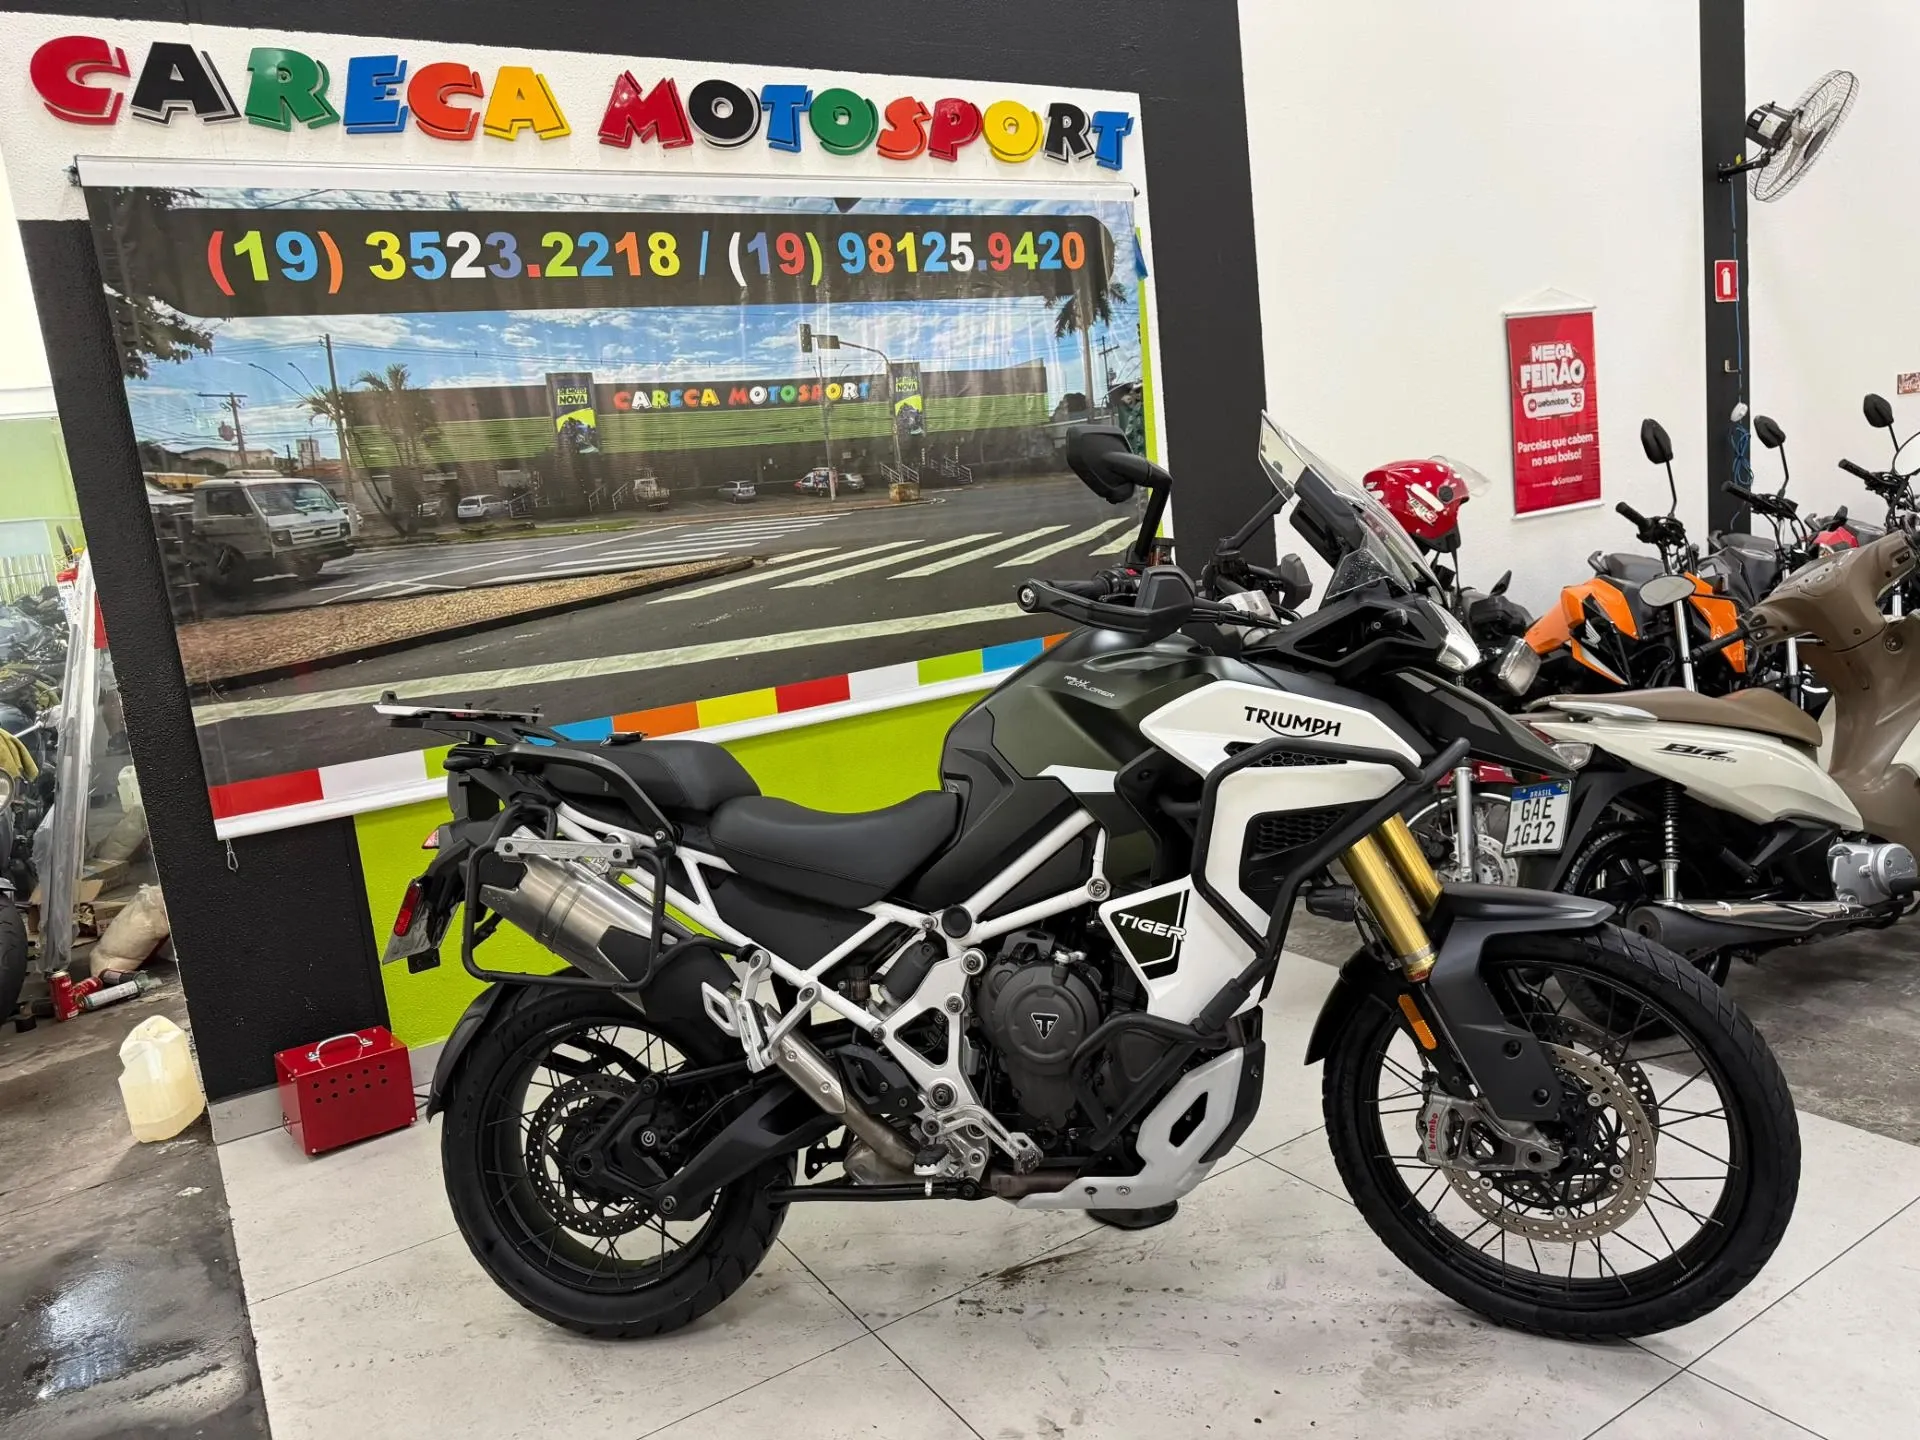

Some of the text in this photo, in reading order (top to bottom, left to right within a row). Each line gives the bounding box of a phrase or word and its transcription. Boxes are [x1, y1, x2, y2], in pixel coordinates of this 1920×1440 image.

[30, 35, 1134, 171] CARECA MOTOSPORT
[207, 230, 1086, 296] (19) 3523.2218 / (19) 98125.9420
[1531, 342, 1574, 363] MEGA
[896, 382, 917, 392] NOVA
[1520, 357, 1585, 390] FEIRÃO
[559, 394, 587, 405] NOVA
[613, 382, 870, 411] CARECA MOTOSPORT
[1517, 432, 1594, 454] Parcelas que cabem
[1531, 447, 1583, 468] no seu bolso!
[1244, 705, 1342, 738] TRIUMPH
[1529, 788, 1553, 799] BRASIL
[1520, 796, 1555, 822] GAE
[1511, 820, 1556, 847] 1G12
[1117, 912, 1188, 942] TIGER
[1427, 1112, 1439, 1151] brembo
